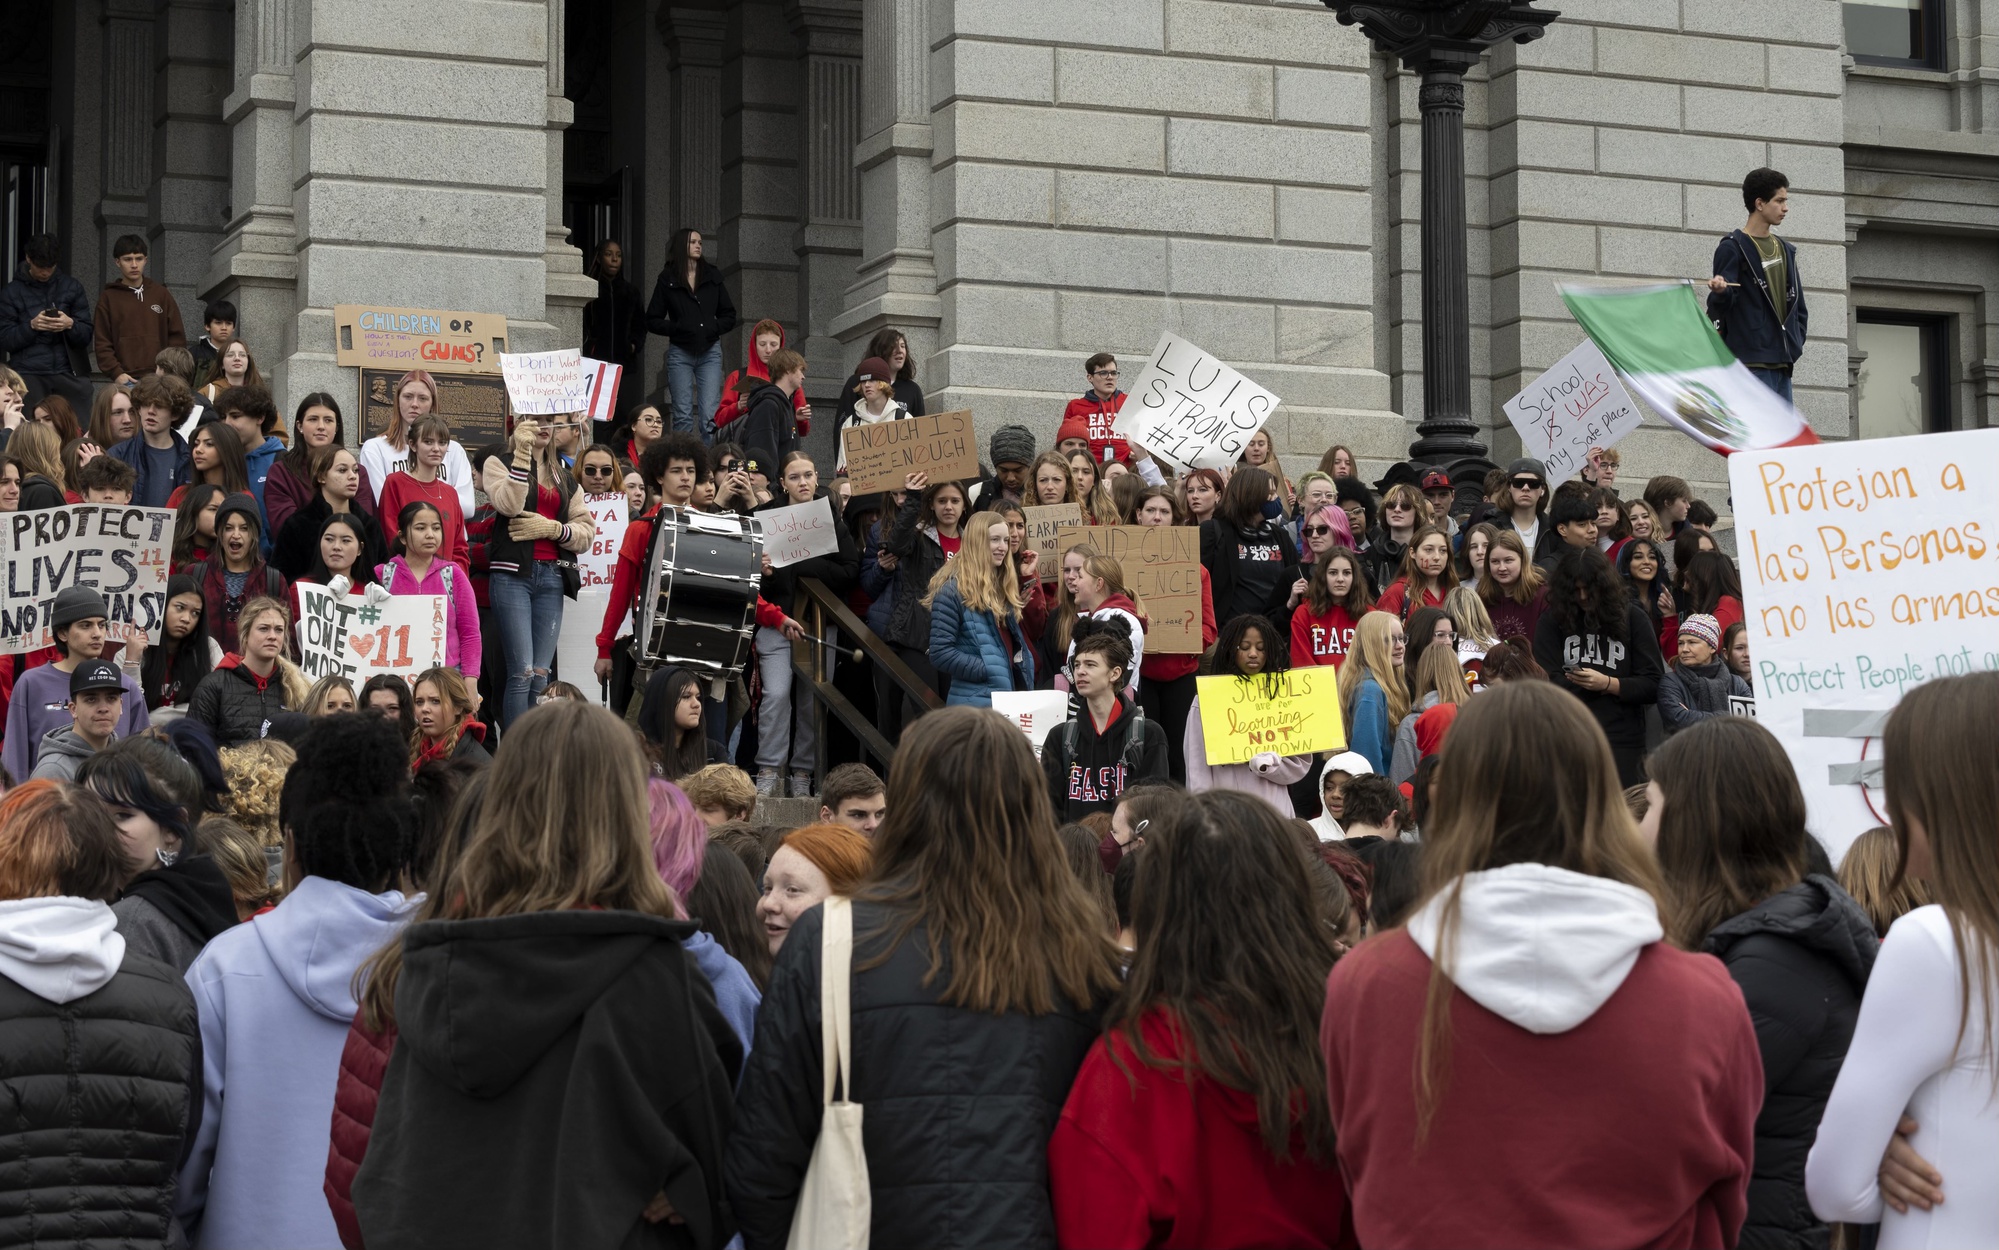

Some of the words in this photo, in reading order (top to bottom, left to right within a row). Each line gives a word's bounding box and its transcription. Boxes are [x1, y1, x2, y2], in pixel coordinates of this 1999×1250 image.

[359, 311, 441, 334] CHILDREN
[449, 319, 473, 333] OR
[421, 340, 484, 363] GUNS?
[559, 355, 581, 369] Want
[1155, 342, 1270, 430] LUIS
[1518, 364, 1585, 424] School
[1564, 373, 1609, 418] WAS
[544, 398, 588, 413] ACTION
[1142, 378, 1242, 458] STRONG
[846, 419, 919, 452] ENOUGH
[929, 412, 965, 437] IS
[1146, 422, 1205, 471] #11
[891, 437, 966, 468] ENOUGH
[1544, 448, 1575, 476] my
[583, 491, 627, 504] CARIEST
[1758, 461, 1918, 516] Protejan
[1940, 462, 1966, 492] a
[12, 506, 172, 551] PROTECT
[603, 509, 618, 521] A
[767, 512, 823, 537] Justice
[592, 539, 615, 556] BE
[787, 533, 802, 543] for
[1141, 528, 1191, 563] GUN
[1250, 550, 1282, 561] 2025
[8, 549, 139, 598] LIVES
[1749, 529, 1810, 586] las
[1137, 569, 1198, 597] ENCE
[1, 597, 57, 638] NOT
[304, 590, 357, 628] NOT
[1760, 604, 1807, 638] no
[1826, 595, 1875, 635] las
[1891, 586, 1999, 626] armas
[307, 615, 348, 659] ONE
[1563, 633, 1626, 670] GAP
[1232, 673, 1312, 704] SCHOOLS
[1759, 659, 1846, 699] Protect
[1936, 645, 1972, 679] not
[1227, 707, 1314, 736] learning
[1248, 726, 1293, 745] NOT
